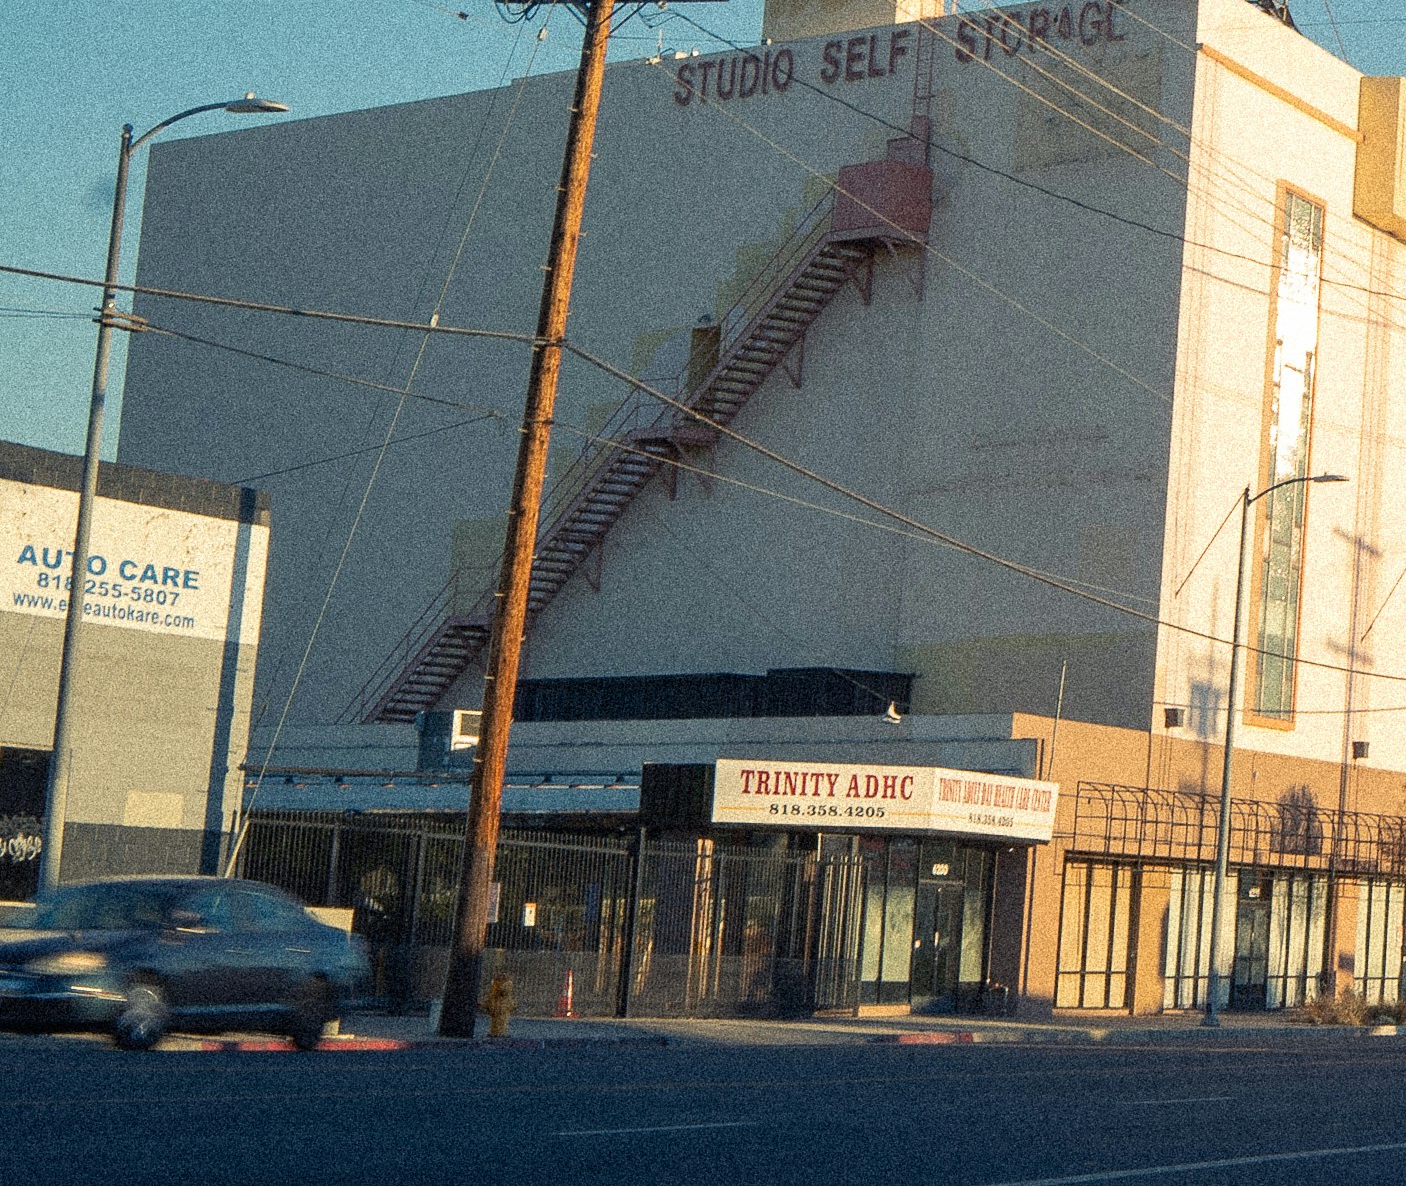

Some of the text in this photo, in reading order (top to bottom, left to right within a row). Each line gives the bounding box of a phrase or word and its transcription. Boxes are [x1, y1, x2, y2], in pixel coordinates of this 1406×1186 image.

[674, 49, 795, 107] STUDIO
[820, 29, 911, 84] SELF
[119, 560, 200, 590] CARE
[740, 769, 914, 801] TRINITY ADHC
[769, 803, 886, 818] 818.358.4205
